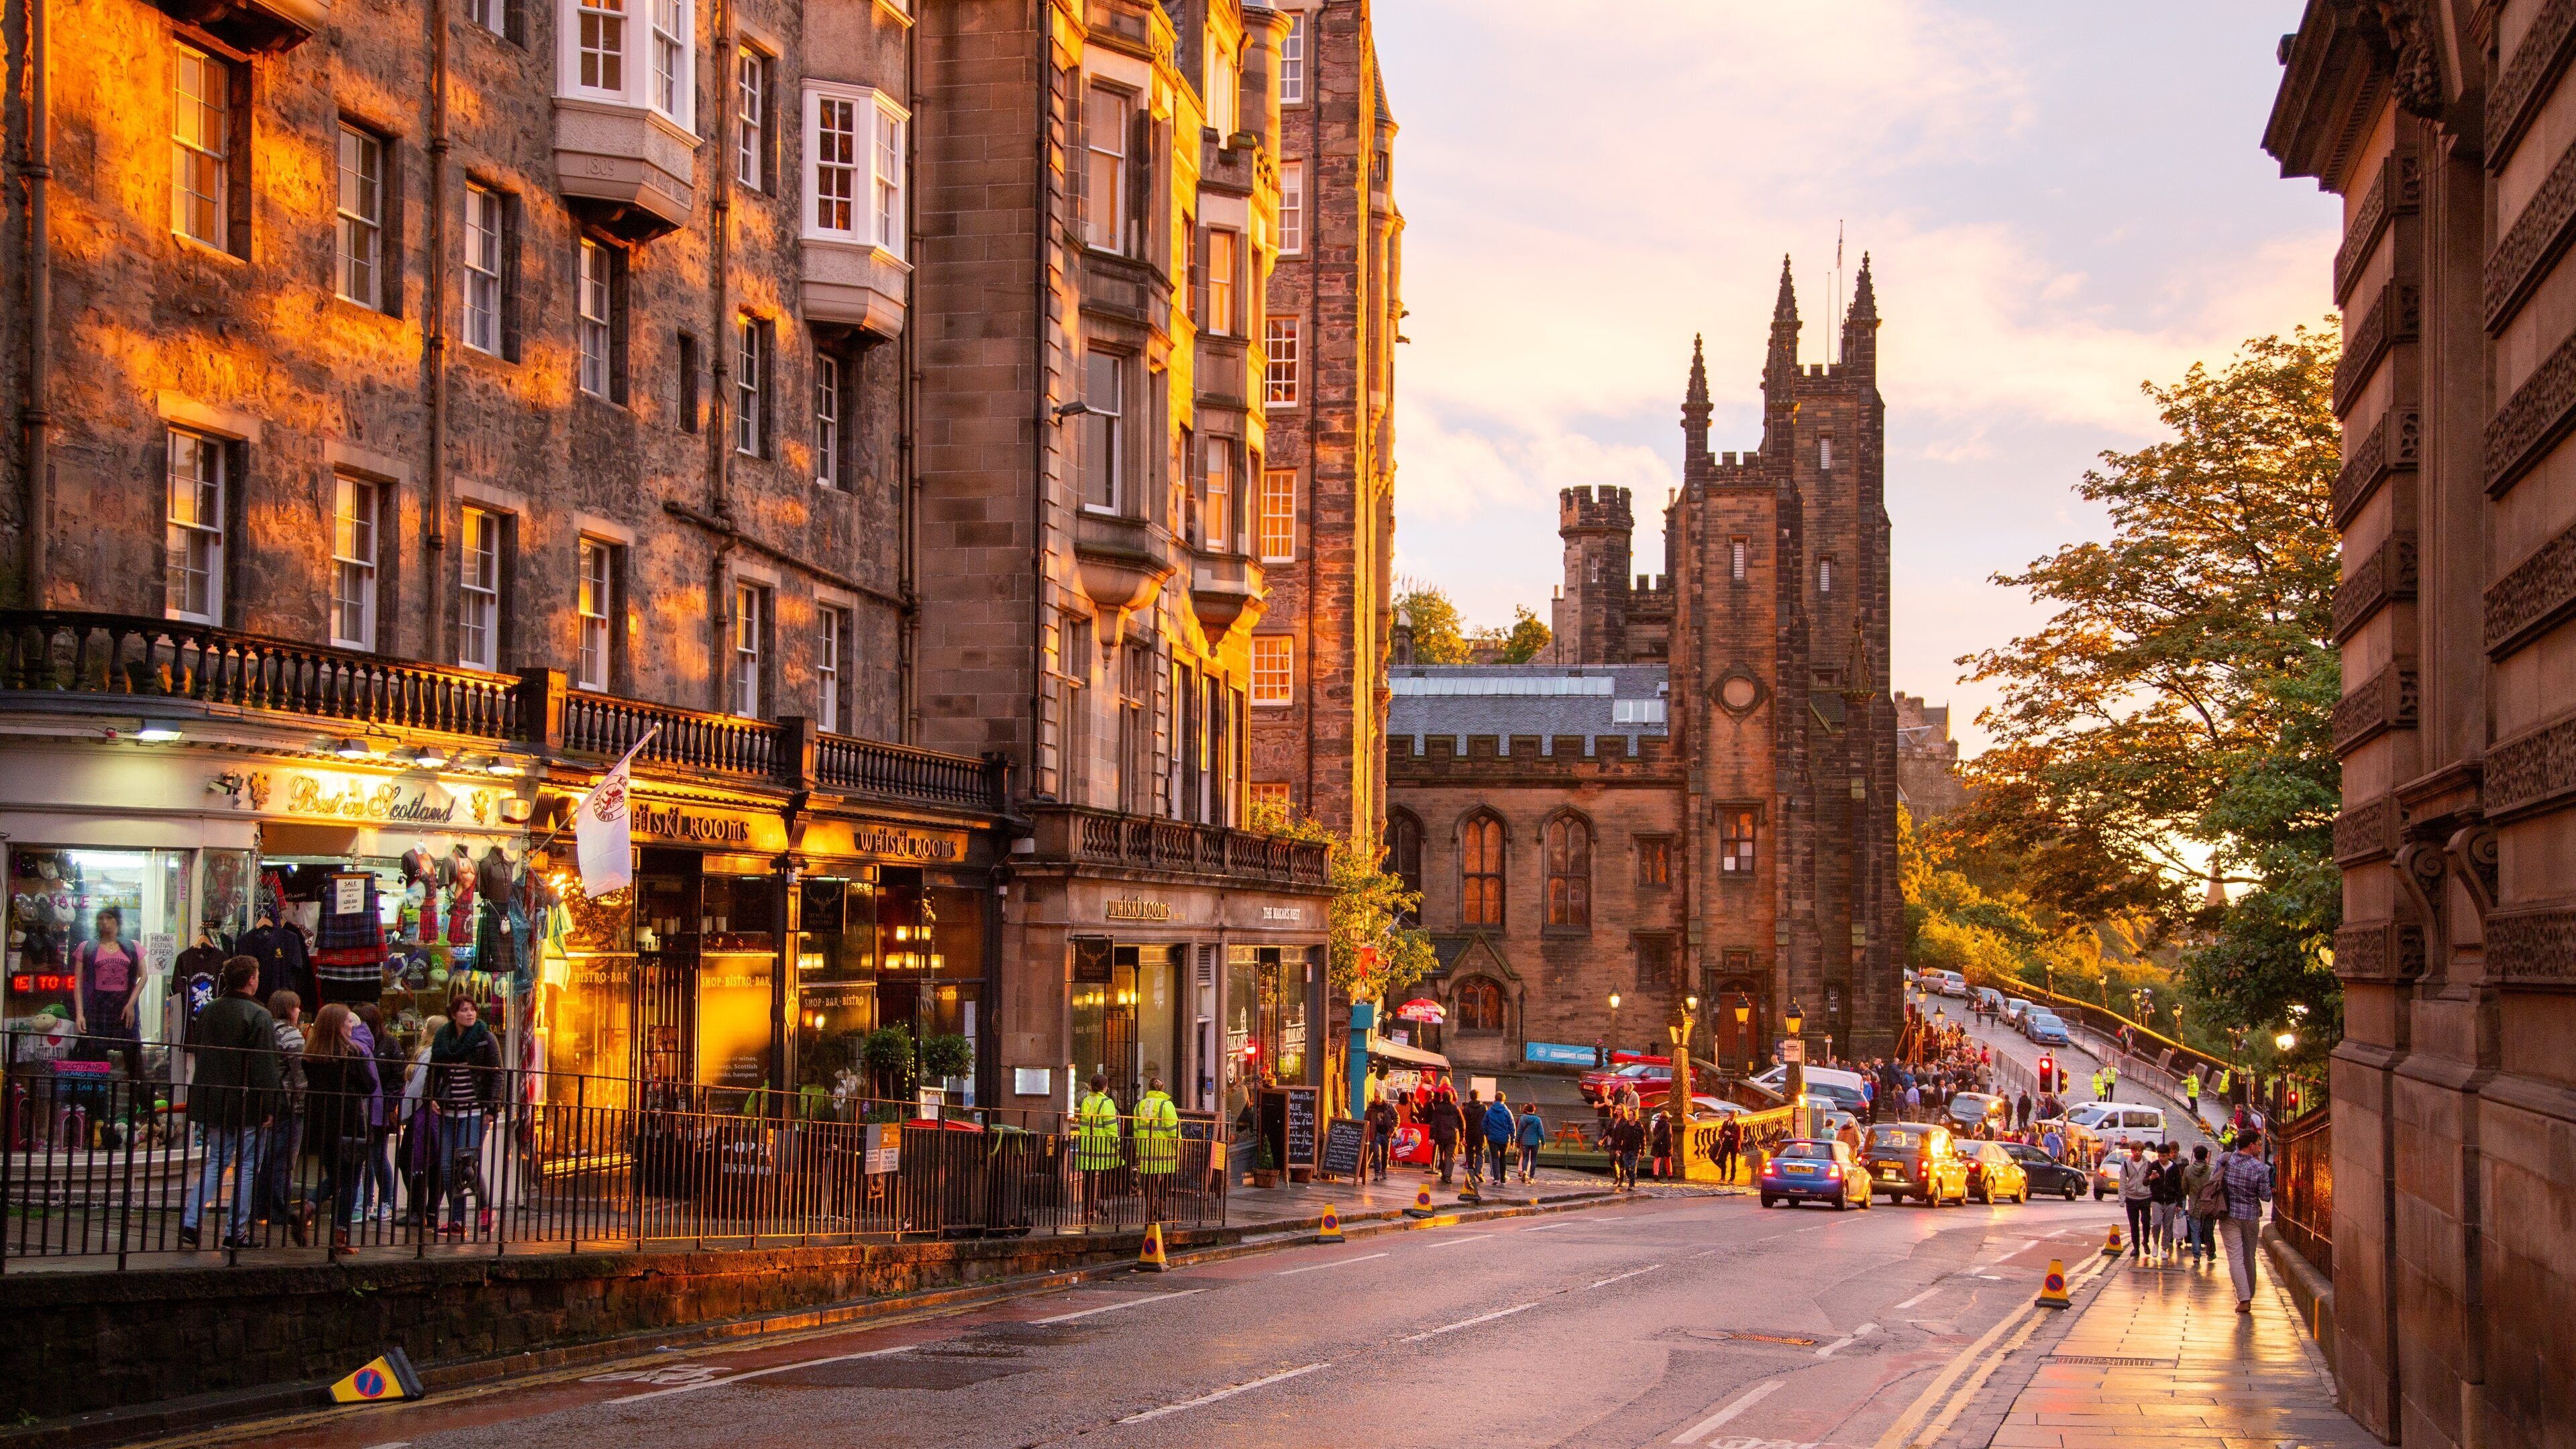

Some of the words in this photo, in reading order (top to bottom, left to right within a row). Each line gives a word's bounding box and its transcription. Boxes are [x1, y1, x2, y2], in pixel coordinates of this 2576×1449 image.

[586, 156, 614, 176] 1809
[368, 783, 456, 822] Scotland
[631, 803, 682, 839] HISKI
[689, 818, 750, 841] ROOMS
[914, 838, 957, 859] ROOMS
[180, 855, 189, 900] SALE
[49, 896, 91, 908] SALE
[103, 896, 140, 908] SALE
[1143, 902, 1171, 919] ROOMS
[1263, 907, 1273, 919] THE
[1273, 906, 1290, 920] MAKAR'S
[1290, 908, 1301, 920] REST
[150, 949, 174, 957] OFFERS
[38, 976, 58, 989] TO
[574, 971, 606, 983] BISTRO
[610, 972, 631, 984] BAR
[701, 977, 722, 987] SHOP
[725, 973, 752, 987] BISTRO
[755, 976, 772, 987] BAR
[805, 998, 822, 1007] SHOP
[825, 997, 839, 1007] BAR
[842, 994, 864, 1006] BISTRO
[1285, 1026, 1306, 1043] MAKAR'S
[1296, 1042, 1305, 1053] REST
[1551, 1051, 1576, 1059] EDINBURGH
